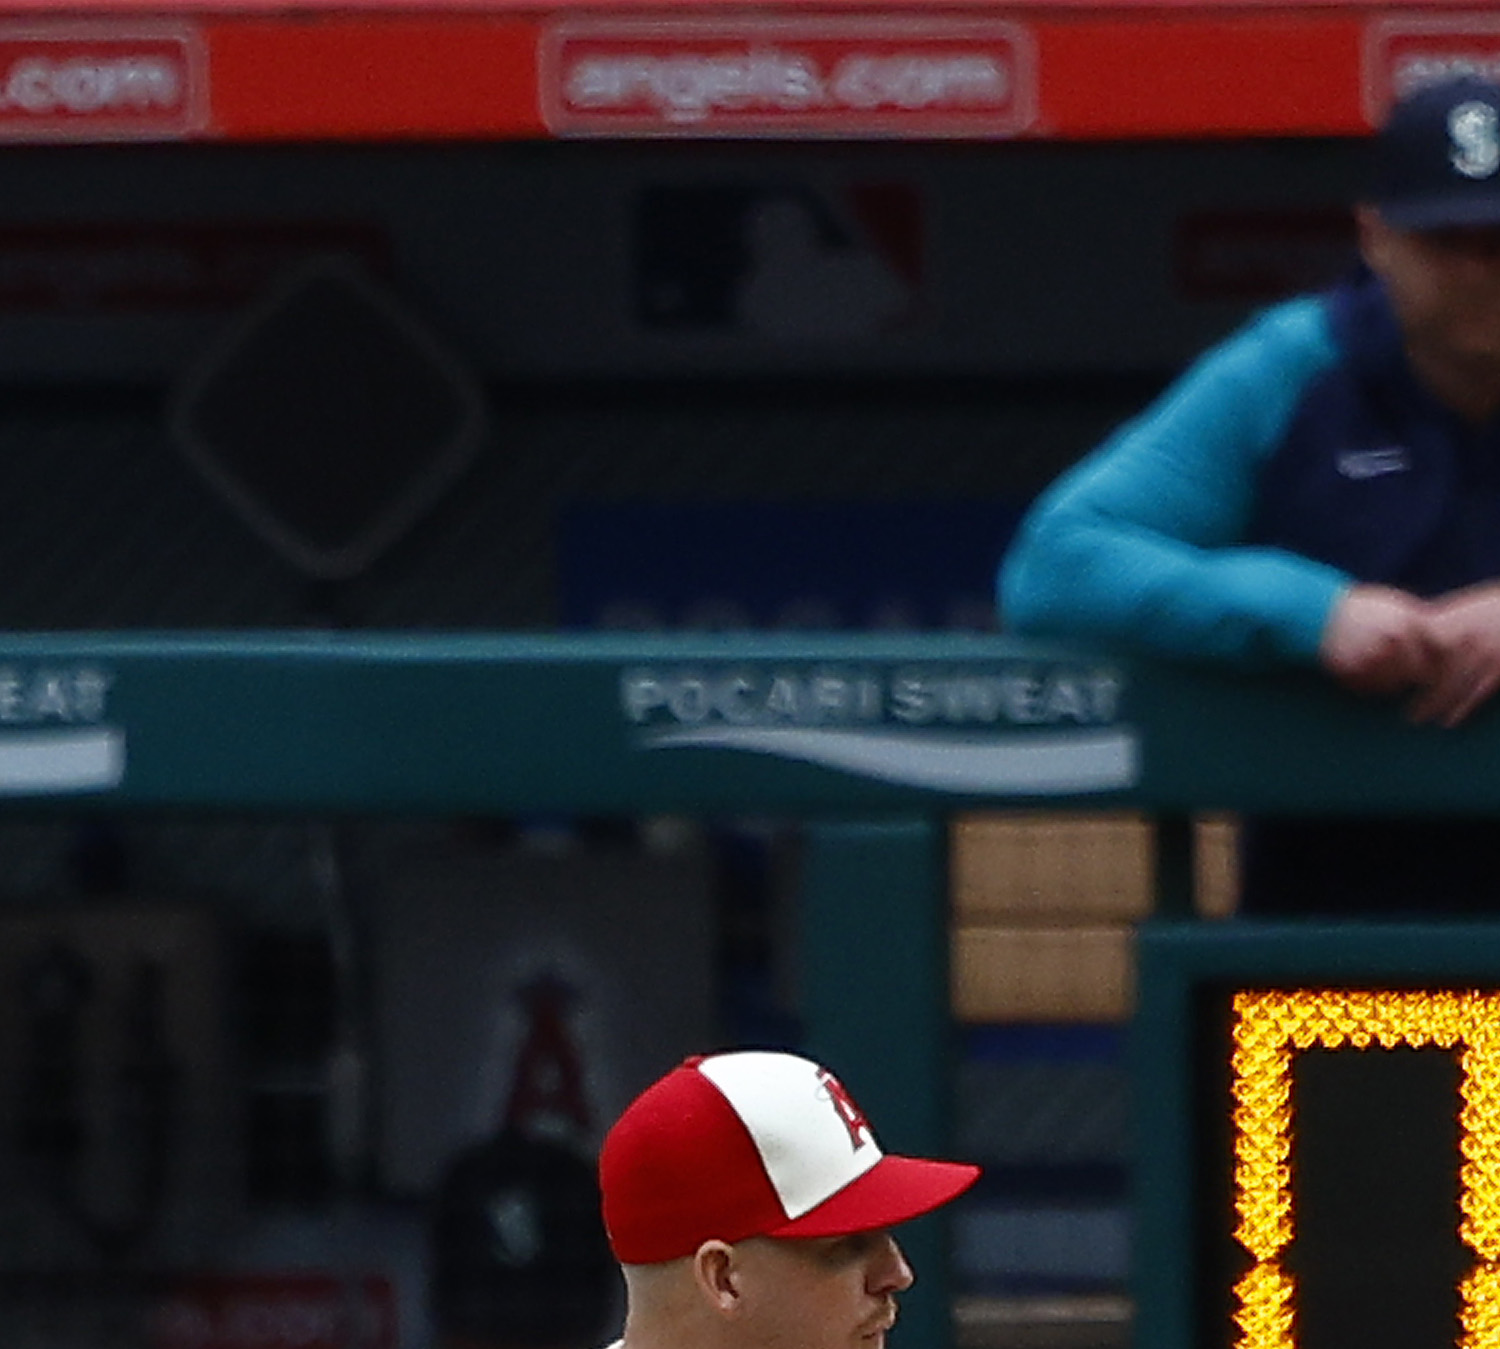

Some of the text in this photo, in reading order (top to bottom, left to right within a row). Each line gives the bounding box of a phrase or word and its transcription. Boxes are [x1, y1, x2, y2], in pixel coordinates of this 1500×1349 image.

[568, 52, 1004, 122] angels.com
[1446, 100, 1500, 179] S
[620, 668, 1120, 724] POCARI SWEAT
